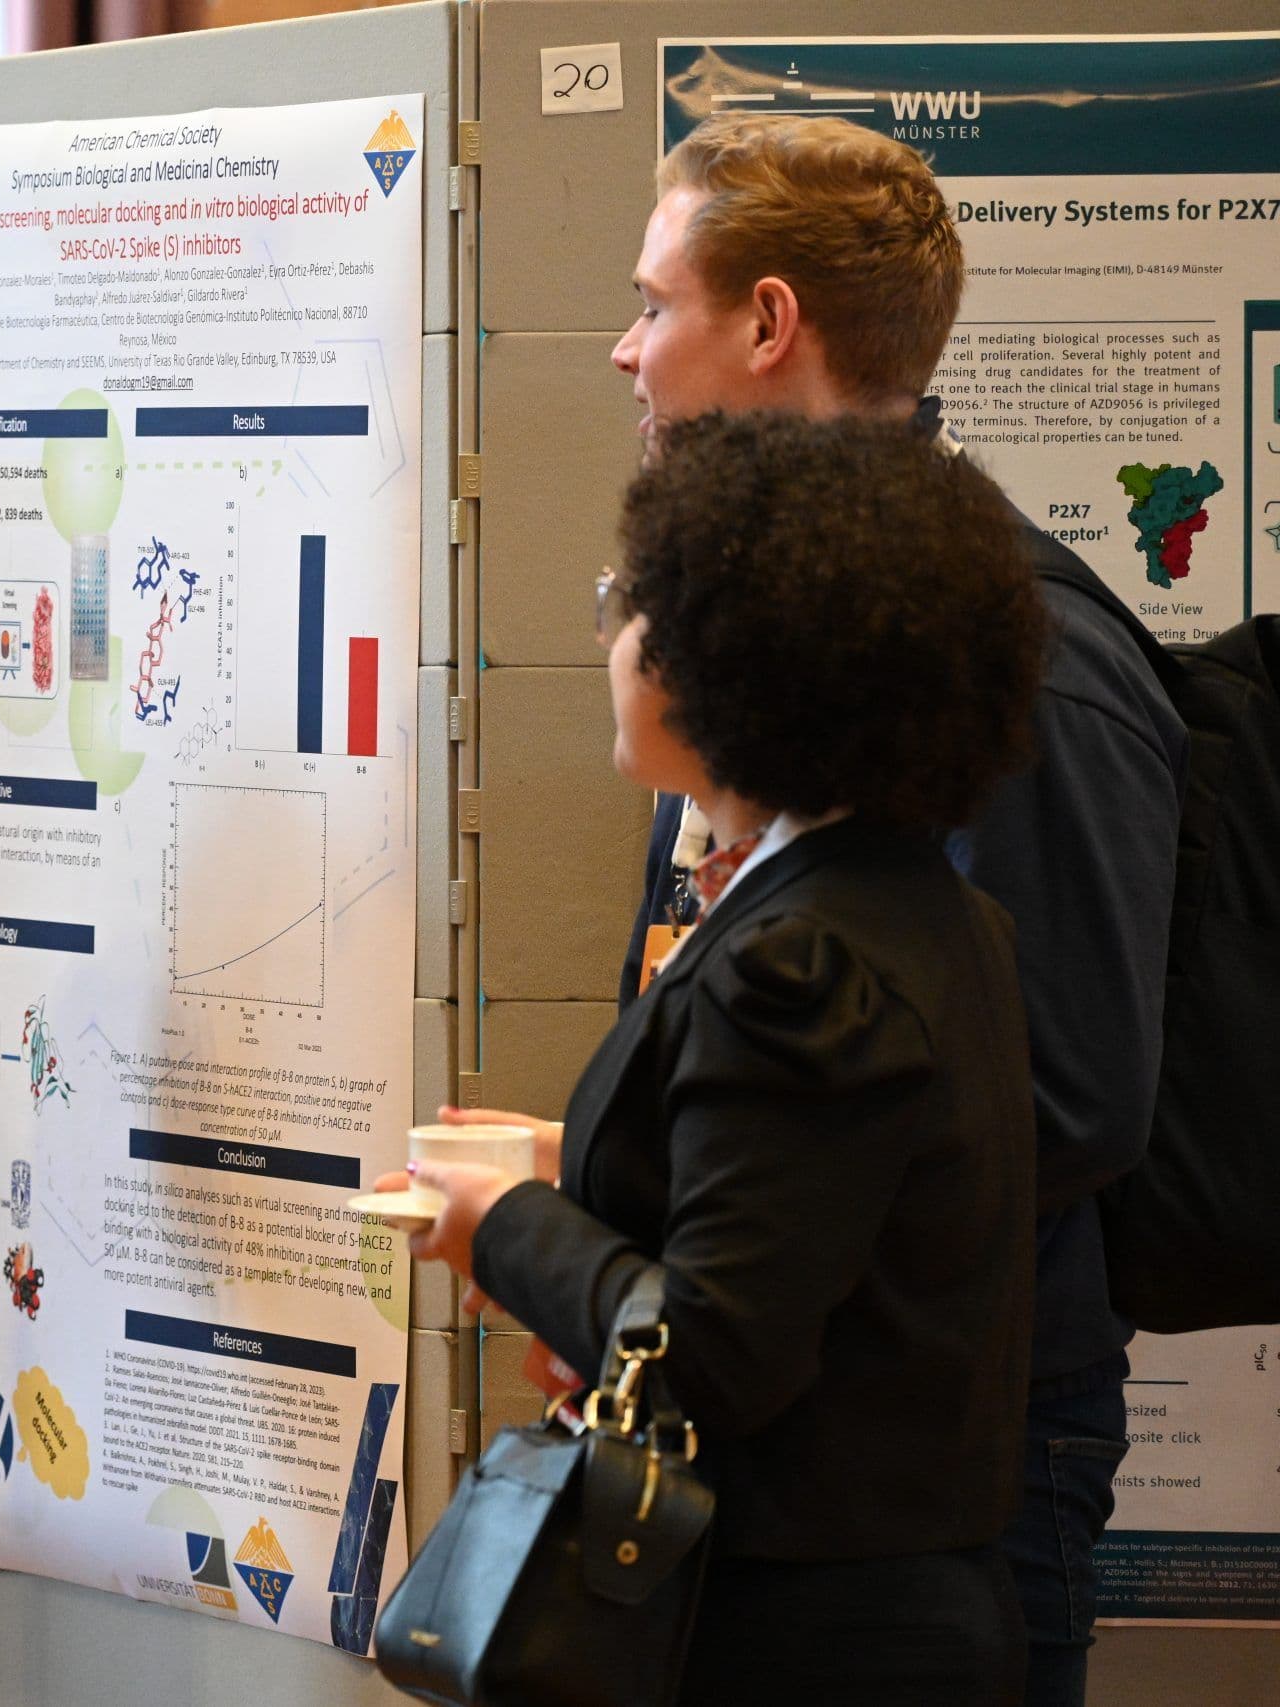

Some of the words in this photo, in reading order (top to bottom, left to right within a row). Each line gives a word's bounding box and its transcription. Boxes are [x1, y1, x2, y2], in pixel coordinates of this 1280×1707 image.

[554, 63, 608, 97] 20
[890, 91, 981, 120] WWU
[70, 133, 123, 152] American
[125, 128, 179, 149] Chemical
[178, 125, 222, 147] Society
[893, 124, 981, 139] MÜNSTER
[12, 169, 72, 193] Symposium
[75, 164, 128, 189] Biological
[130, 161, 152, 183] and
[155, 159, 212, 181] Medicinal
[216, 157, 279, 179] Chemistry
[0, 207, 53, 231] screening,
[57, 204, 112, 225] molecular
[115, 201, 161, 226] docking
[164, 200, 187, 221] and
[190, 199, 201, 220] in
[205, 198, 234, 219] vitro
[237, 195, 298, 221] biological
[302, 193, 351, 216] activity
[354, 189, 369, 211] of
[958, 200, 1057, 226] Delivery
[1066, 201, 1168, 225] Systems
[1178, 198, 1210, 220] for
[60, 238, 126, 261] SARS-CoV-2
[129, 237, 160, 262] Spike
[164, 236, 178, 262] (S)
[183, 235, 241, 256] inhibitors
[963, 265, 996, 275] nstitute
[999, 266, 1012, 275] for
[1015, 266, 1060, 276] Molecular
[1064, 266, 1100, 276] Imaging
[1103, 265, 1133, 275] (EIMI),
[1136, 264, 1179, 274] D-48149
[1182, 264, 1222, 273] Münster
[945, 333, 970, 345] nnel
[978, 334, 1035, 346] mediating
[1043, 333, 1098, 345] biological
[1106, 335, 1164, 345] processes
[1172, 332, 1199, 343] such
[1207, 334, 1220, 343] as
[320, 350, 336, 363] USA
[931, 365, 976, 379] omising
[986, 367, 1010, 379] drug
[1020, 366, 1082, 376] candidates
[1092, 365, 1106, 376] for
[1117, 365, 1134, 376] the
[1144, 366, 1198, 376] treatment
[1209, 365, 1220, 375] of
[949, 385, 970, 393] one
[975, 384, 986, 393] to
[991, 383, 1021, 393] reach
[1027, 383, 1044, 393] the
[1050, 382, 1090, 393] clinical
[1096, 382, 1117, 392] trial
[1123, 383, 1153, 394] stage
[1158, 382, 1168, 392] in
[1174, 382, 1219, 392] humans
[233, 414, 265, 430] Results
[959, 431, 1039, 445] armacological
[1044, 432, 1100, 444] properties
[1105, 433, 1124, 441] can
[1129, 431, 1142, 441] be
[1146, 431, 1183, 441] tuned.
[24, 466, 48, 479] deaths
[5, 509, 17, 520] 839
[19, 508, 43, 520] deaths
[1049, 504, 1091, 518] P2X7
[1042, 526, 1109, 543] eceptor¹
[1139, 603, 1167, 615] Side
[1171, 603, 1203, 615] View
[218, 1148, 266, 1169] Conclusion
[104, 1198, 134, 1217] docking
[137, 1202, 149, 1219] led
[151, 1205, 159, 1217] to
[162, 1206, 174, 1220] the
[177, 1209, 216, 1225] detection
[218, 1214, 227, 1227] of
[230, 1215, 244, 1230] B-8
[246, 1220, 256, 1231] as
[258, 1222, 263, 1233] a
[305, 1226, 335, 1243] blocker
[338, 1231, 347, 1245] of
[349, 1233, 392, 1250] S-hACE2
[104, 1221, 133, 1239] binding
[136, 1225, 152, 1239] with
[162, 1229, 199, 1247] biological
[201, 1237, 232, 1254] activity
[234, 1240, 242, 1255] of
[246, 1242, 263, 1256] 48%
[266, 1245, 304, 1263] inhibition
[315, 1256, 376, 1273] concentration
[380, 1262, 392, 1275] of
[214, 1332, 264, 1354] References
[1125, 1404, 1167, 1417] esized
[35, 1392, 68, 1450] Molecular
[32, 1417, 58, 1464] docking
[1171, 1431, 1201, 1443] click
[1112, 1474, 1145, 1488] nists
[1150, 1475, 1201, 1488] showed
